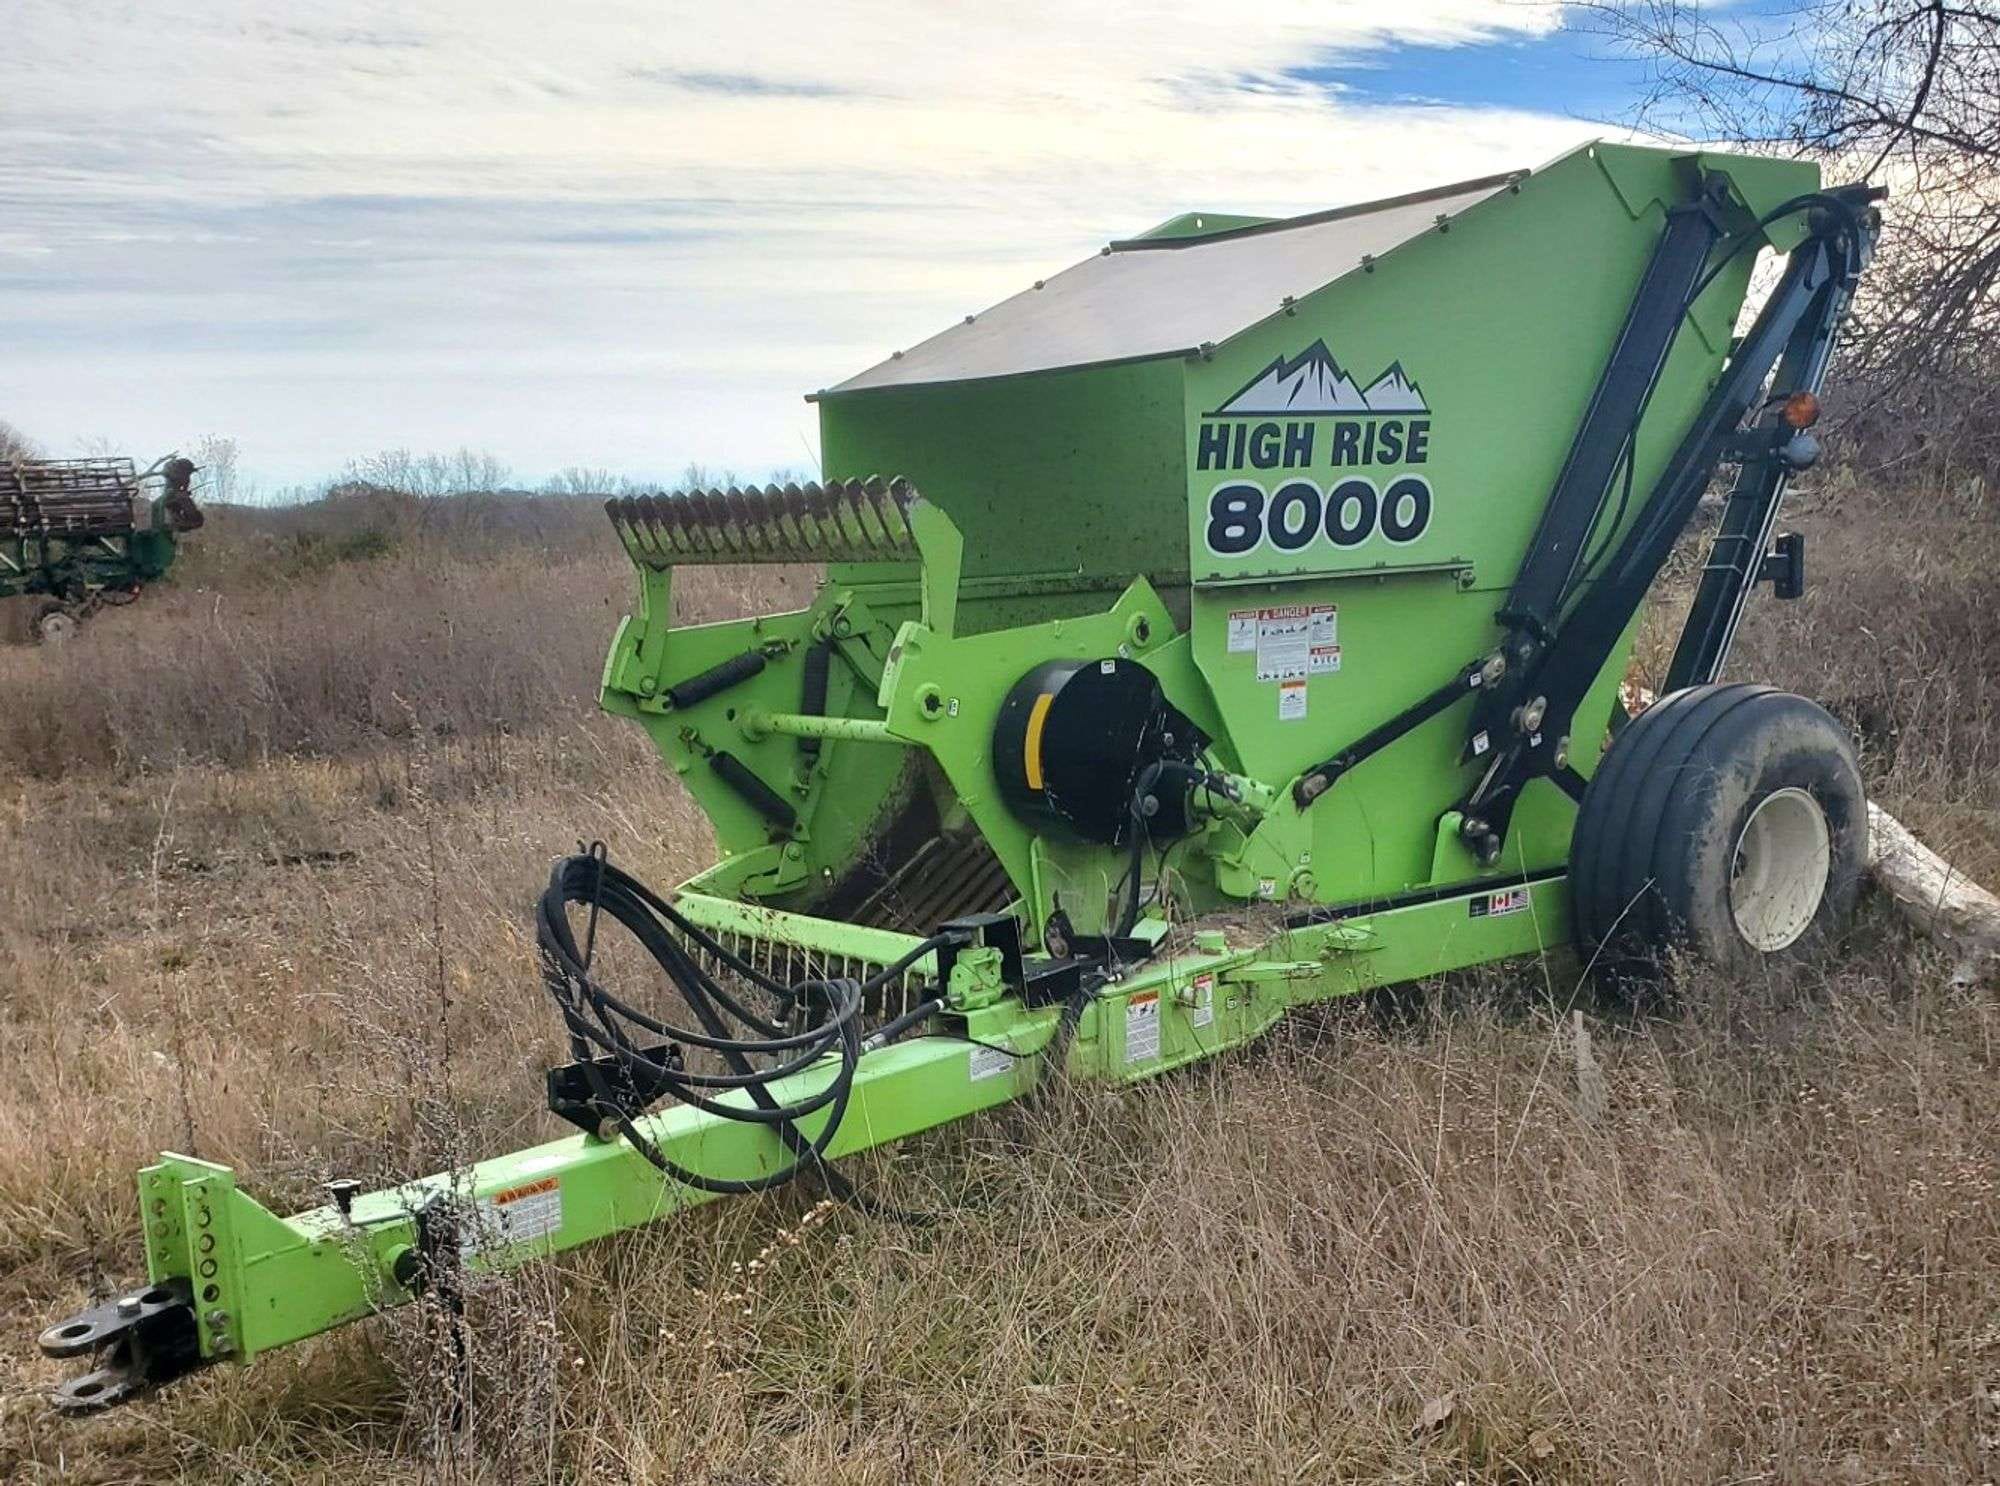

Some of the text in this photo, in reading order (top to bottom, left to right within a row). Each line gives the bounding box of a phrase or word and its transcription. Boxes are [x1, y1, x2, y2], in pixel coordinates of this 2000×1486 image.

[1197, 420, 1431, 471] HIGH RISE
[1205, 475, 1433, 556] 8000
